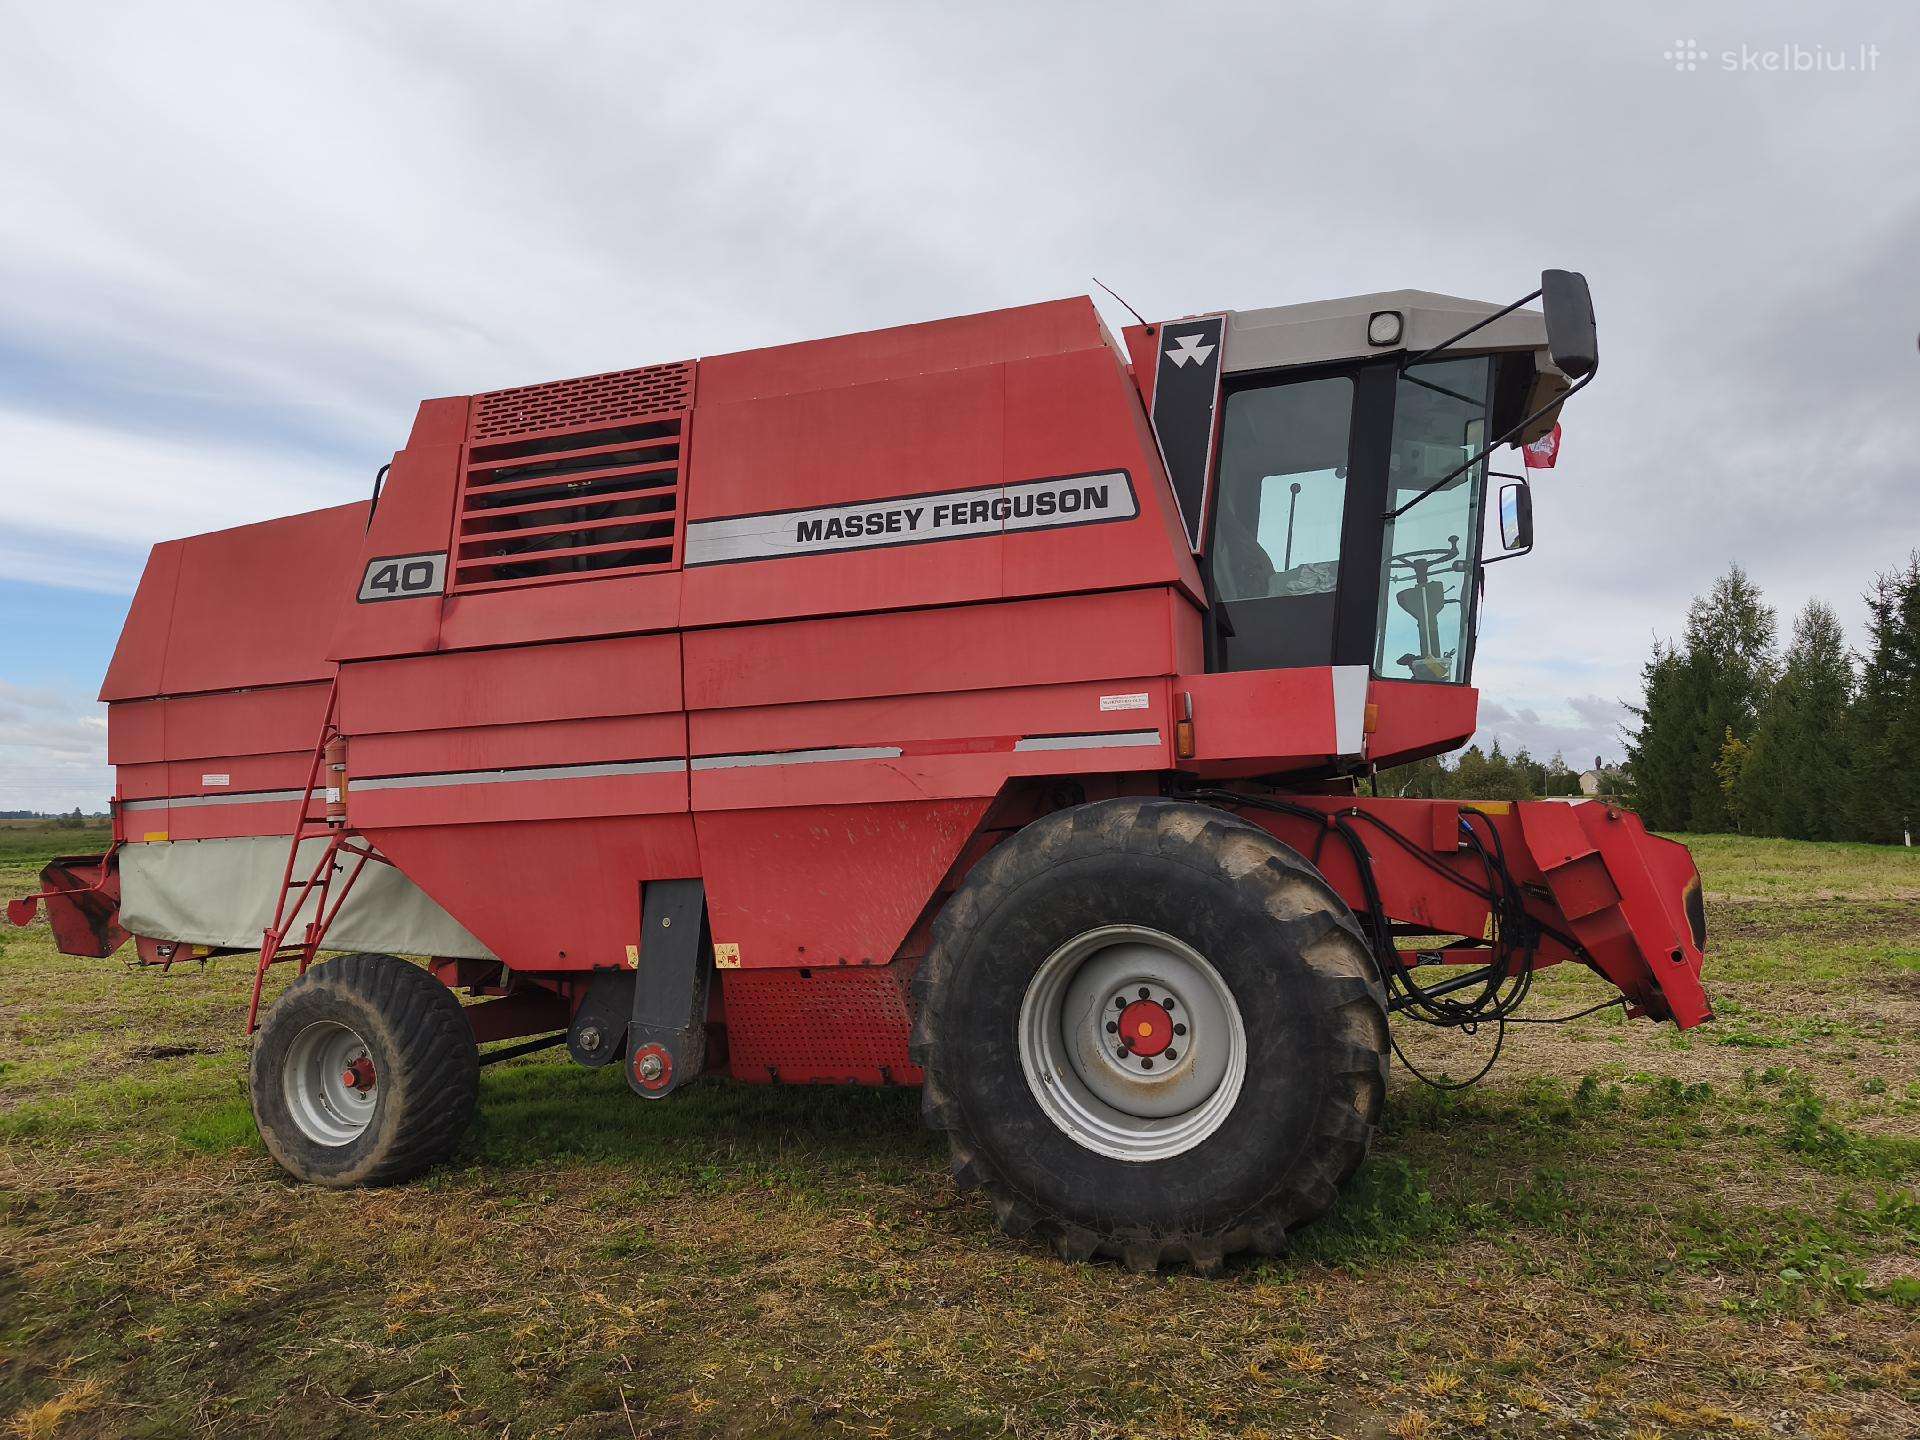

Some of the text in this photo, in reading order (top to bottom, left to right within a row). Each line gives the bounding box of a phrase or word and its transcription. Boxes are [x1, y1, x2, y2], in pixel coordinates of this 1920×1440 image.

[796, 485, 1108, 543] MASSEY FERGUSON
[370, 561, 434, 593] 40
